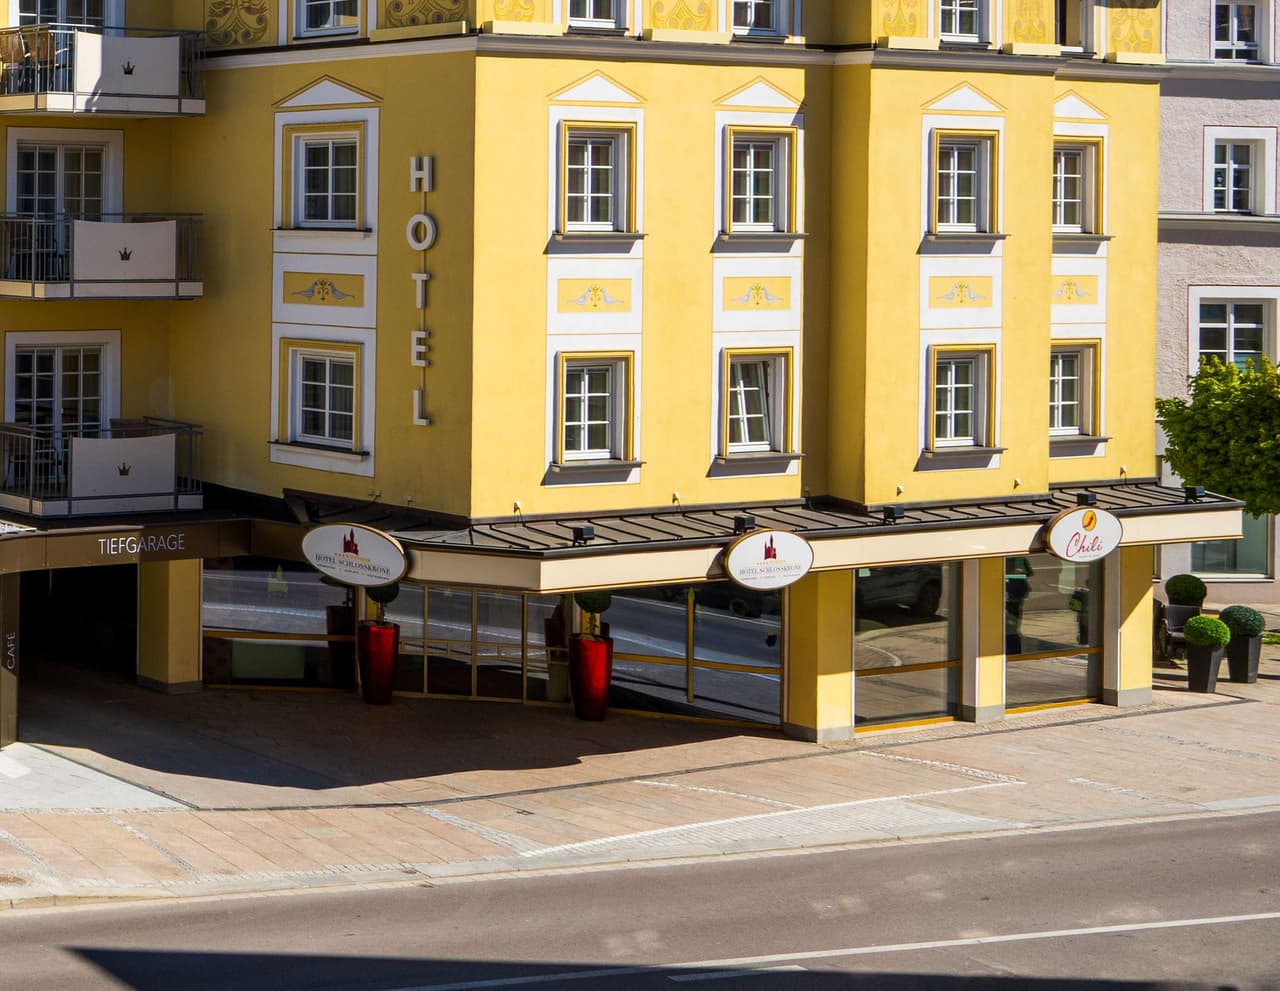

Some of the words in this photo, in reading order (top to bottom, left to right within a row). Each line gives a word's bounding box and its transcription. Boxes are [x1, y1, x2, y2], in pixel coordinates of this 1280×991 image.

[406, 156, 437, 426] HOTEL
[97, 533, 185, 555] TIEFGARAGE
[1066, 531, 1103, 558] Chili
[315, 553, 337, 564] HOTEL
